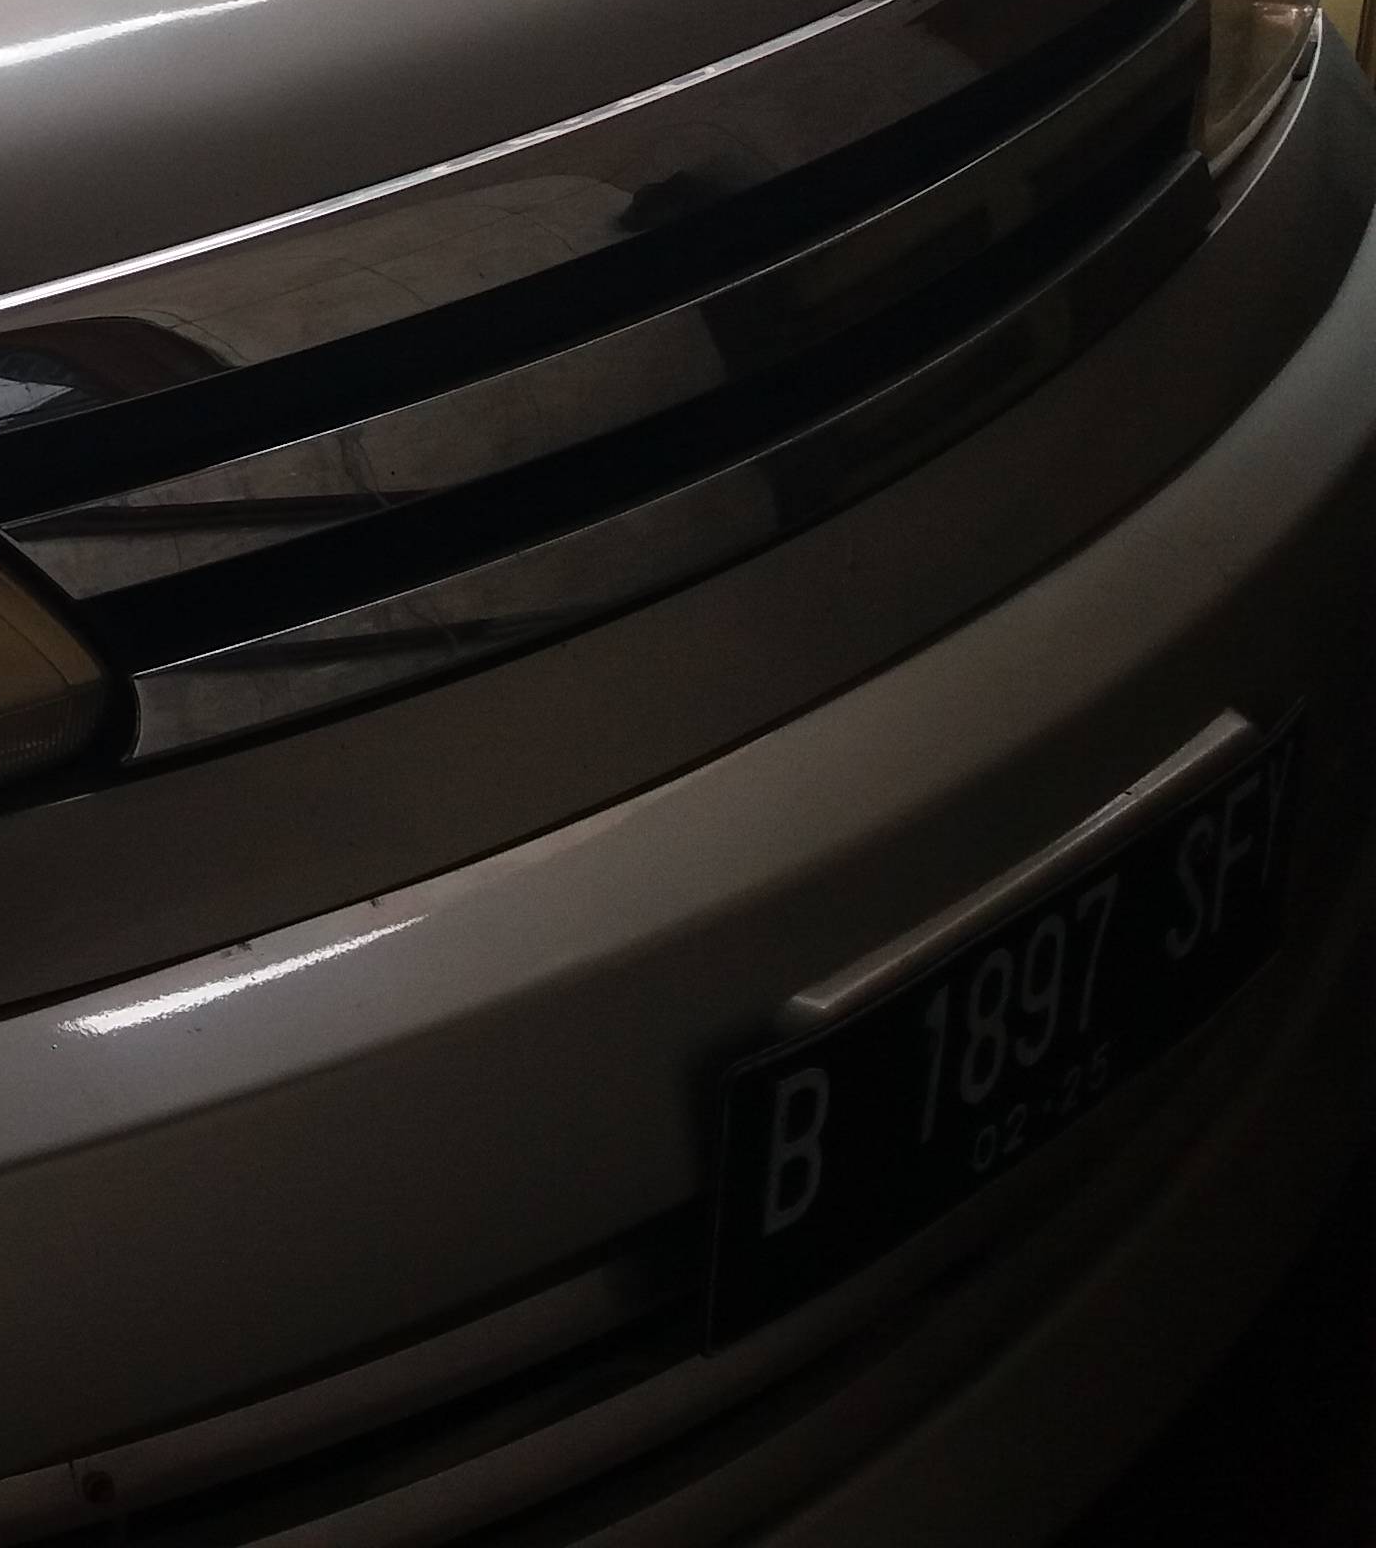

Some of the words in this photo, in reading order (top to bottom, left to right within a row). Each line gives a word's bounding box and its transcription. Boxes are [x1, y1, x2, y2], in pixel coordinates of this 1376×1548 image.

[760, 1064, 831, 1239] B
[918, 870, 1121, 1146] 1897
[1163, 736, 1295, 961] SFY
